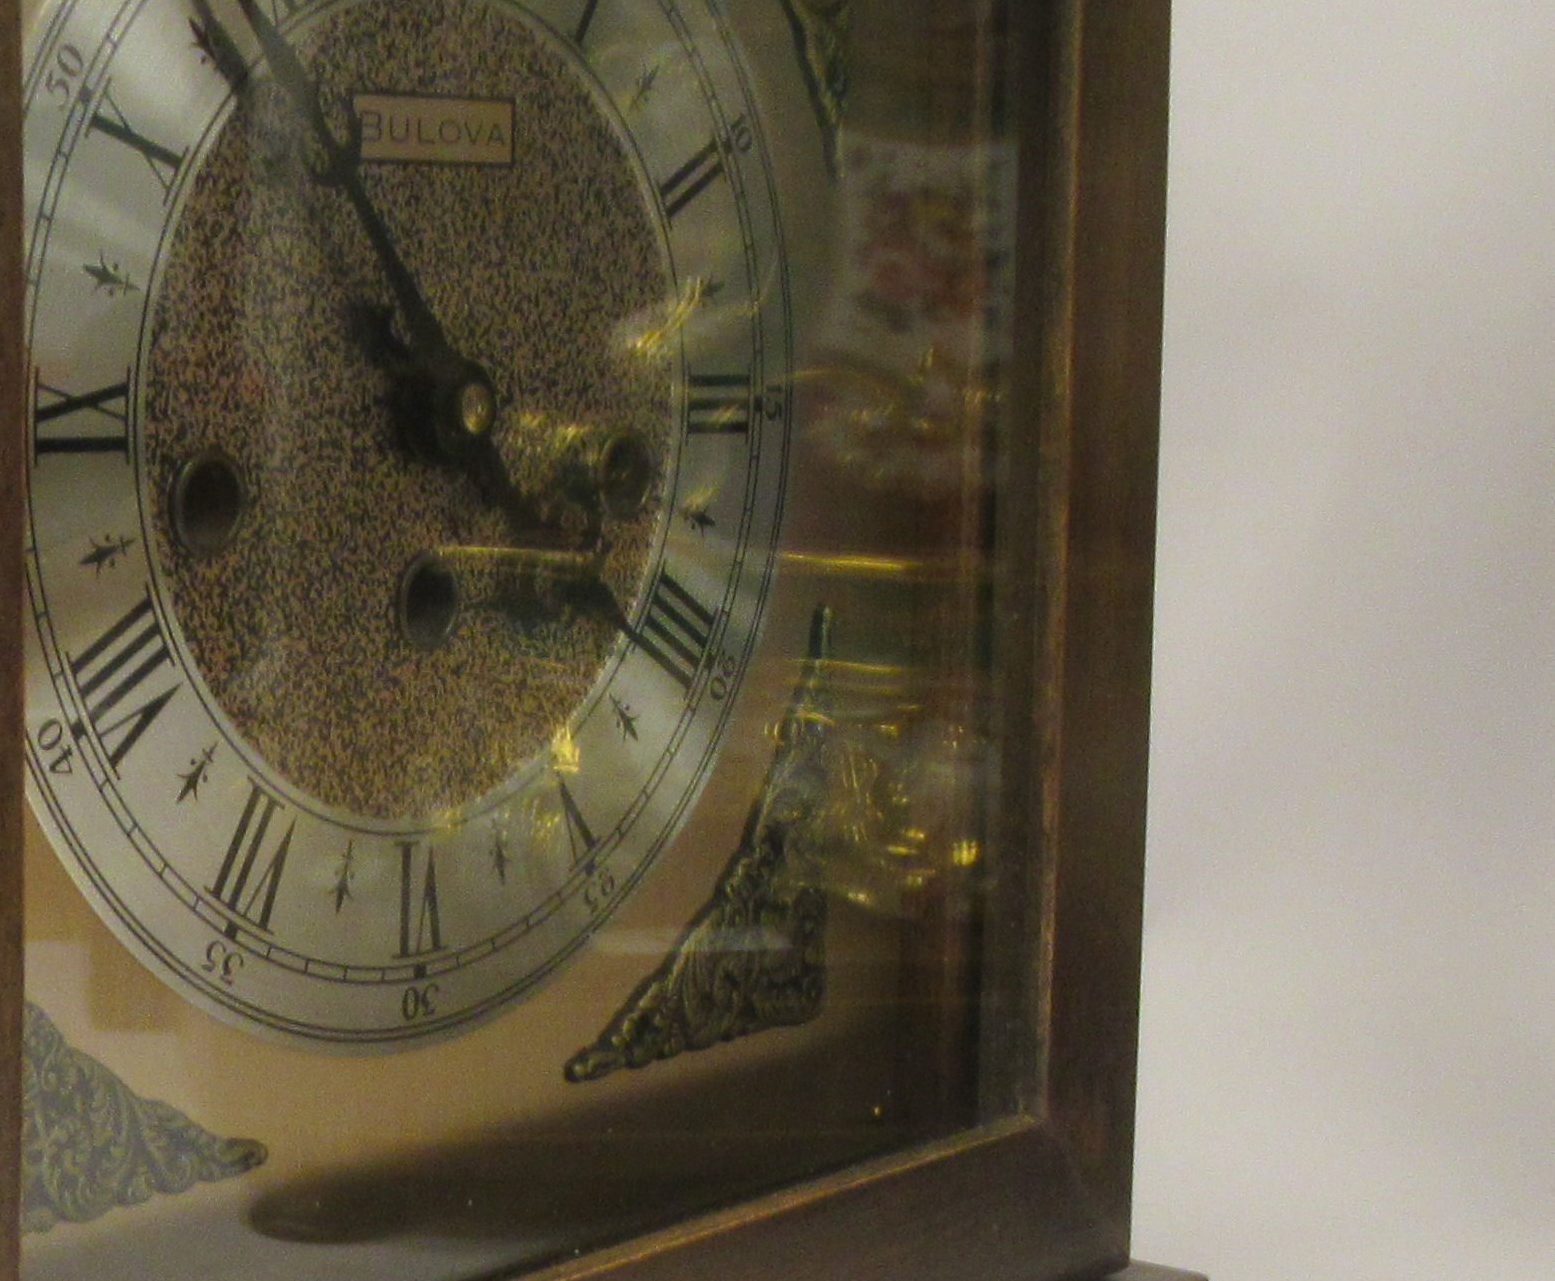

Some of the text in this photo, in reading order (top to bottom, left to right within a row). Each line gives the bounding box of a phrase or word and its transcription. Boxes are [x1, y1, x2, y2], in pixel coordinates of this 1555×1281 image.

[46, 42, 84, 111] 50
[359, 110, 506, 147] BULOVA
[34, 366, 132, 468] IX
[37, 717, 74, 776] 40
[202, 940, 244, 985] 35
[401, 984, 439, 1020] 30
